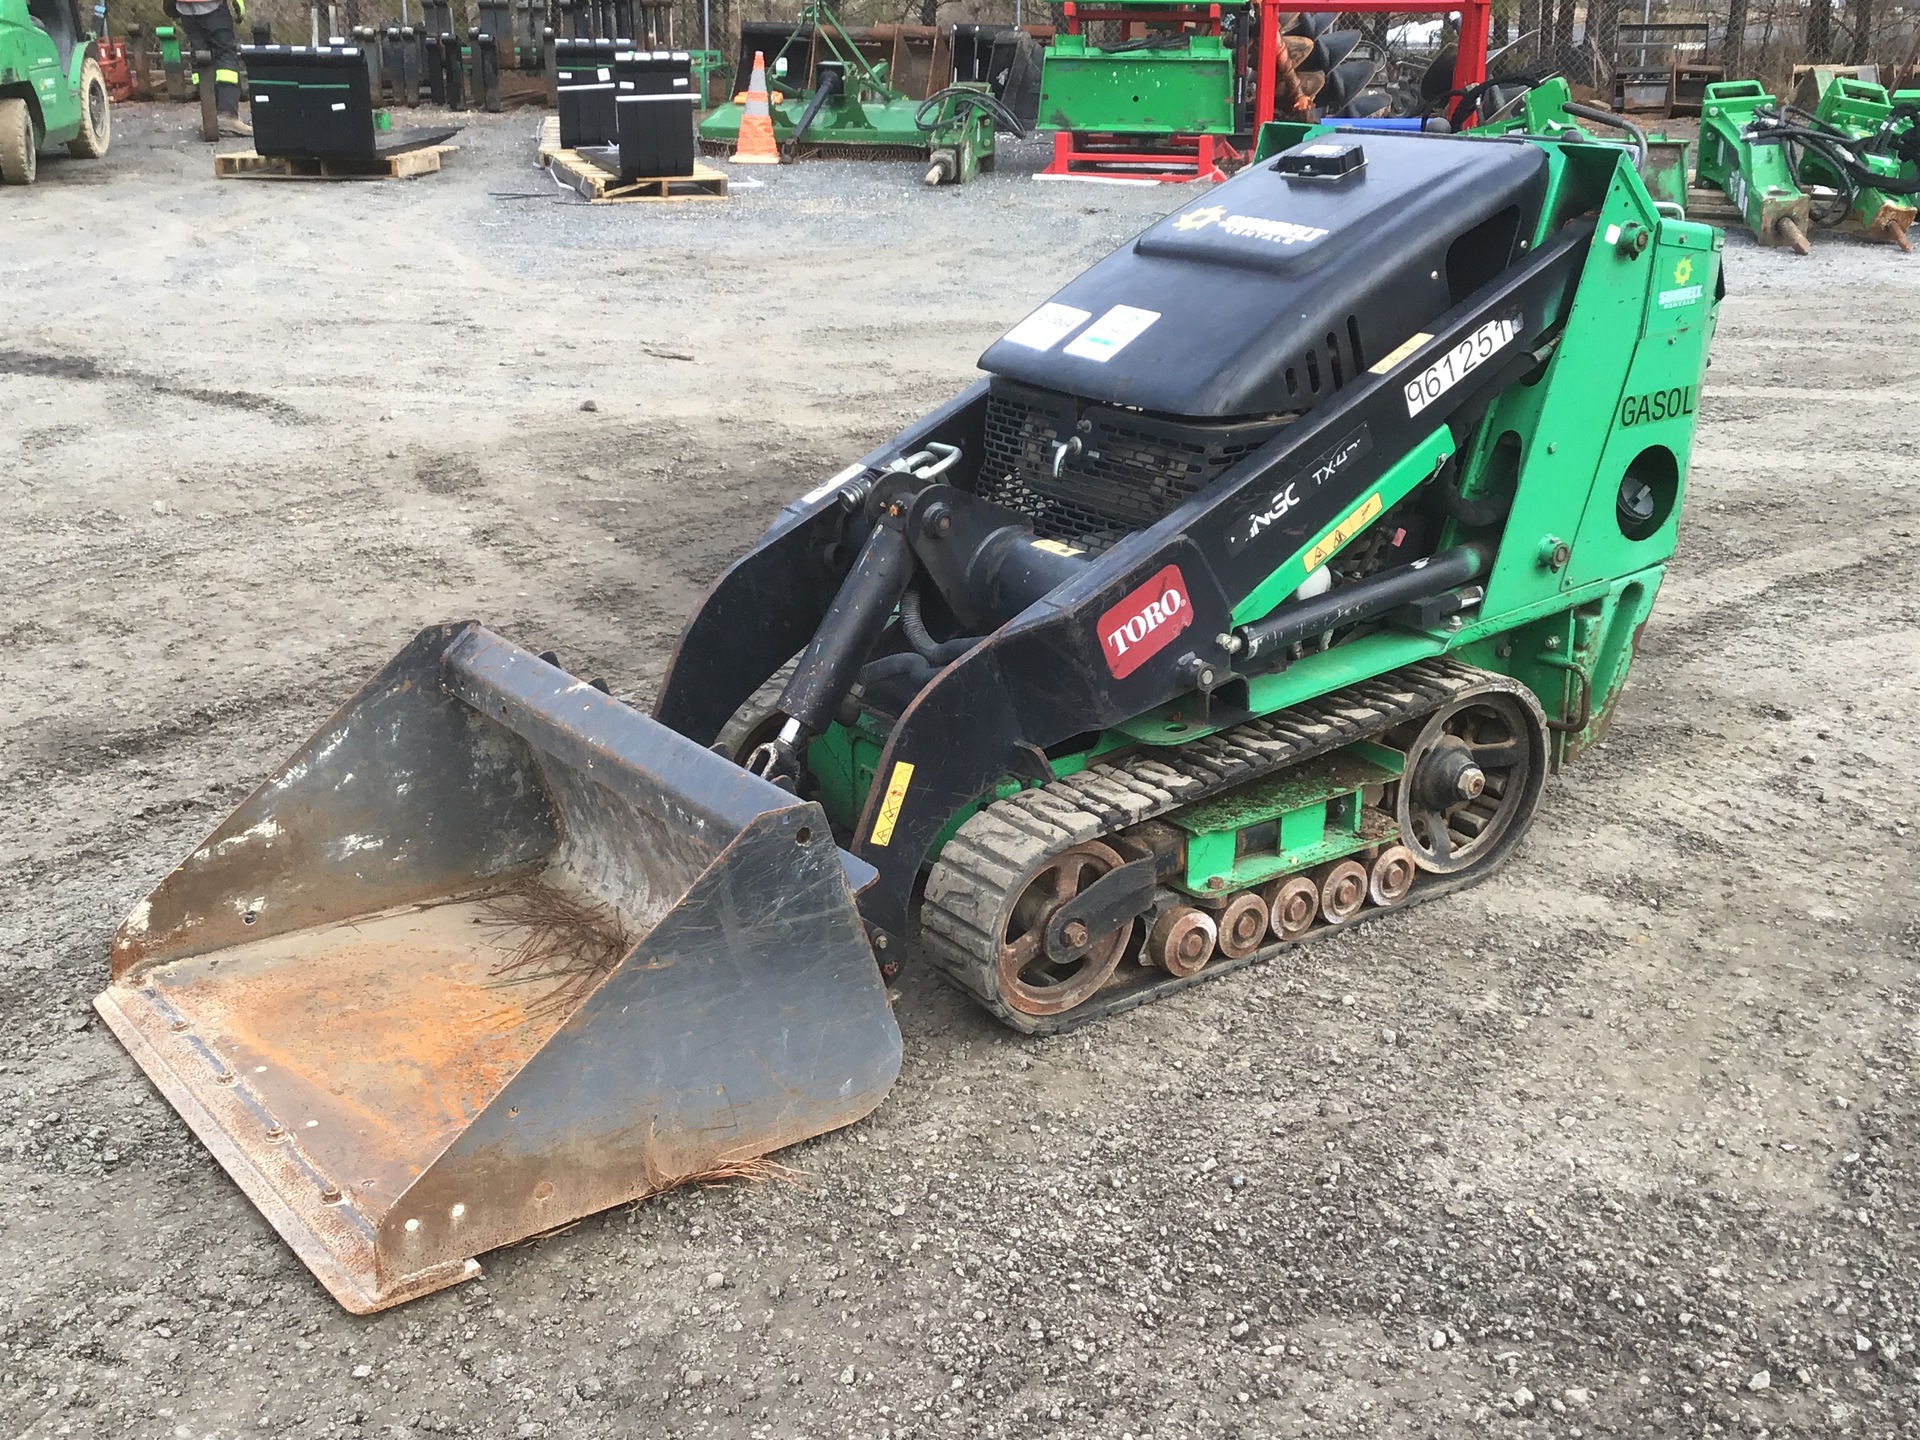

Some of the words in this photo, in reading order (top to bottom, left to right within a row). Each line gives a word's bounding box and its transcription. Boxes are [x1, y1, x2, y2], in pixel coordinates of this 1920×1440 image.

[1407, 320, 1507, 406] 961251
[1621, 386, 1694, 427] GASOL
[1107, 589, 1183, 657] TORO
